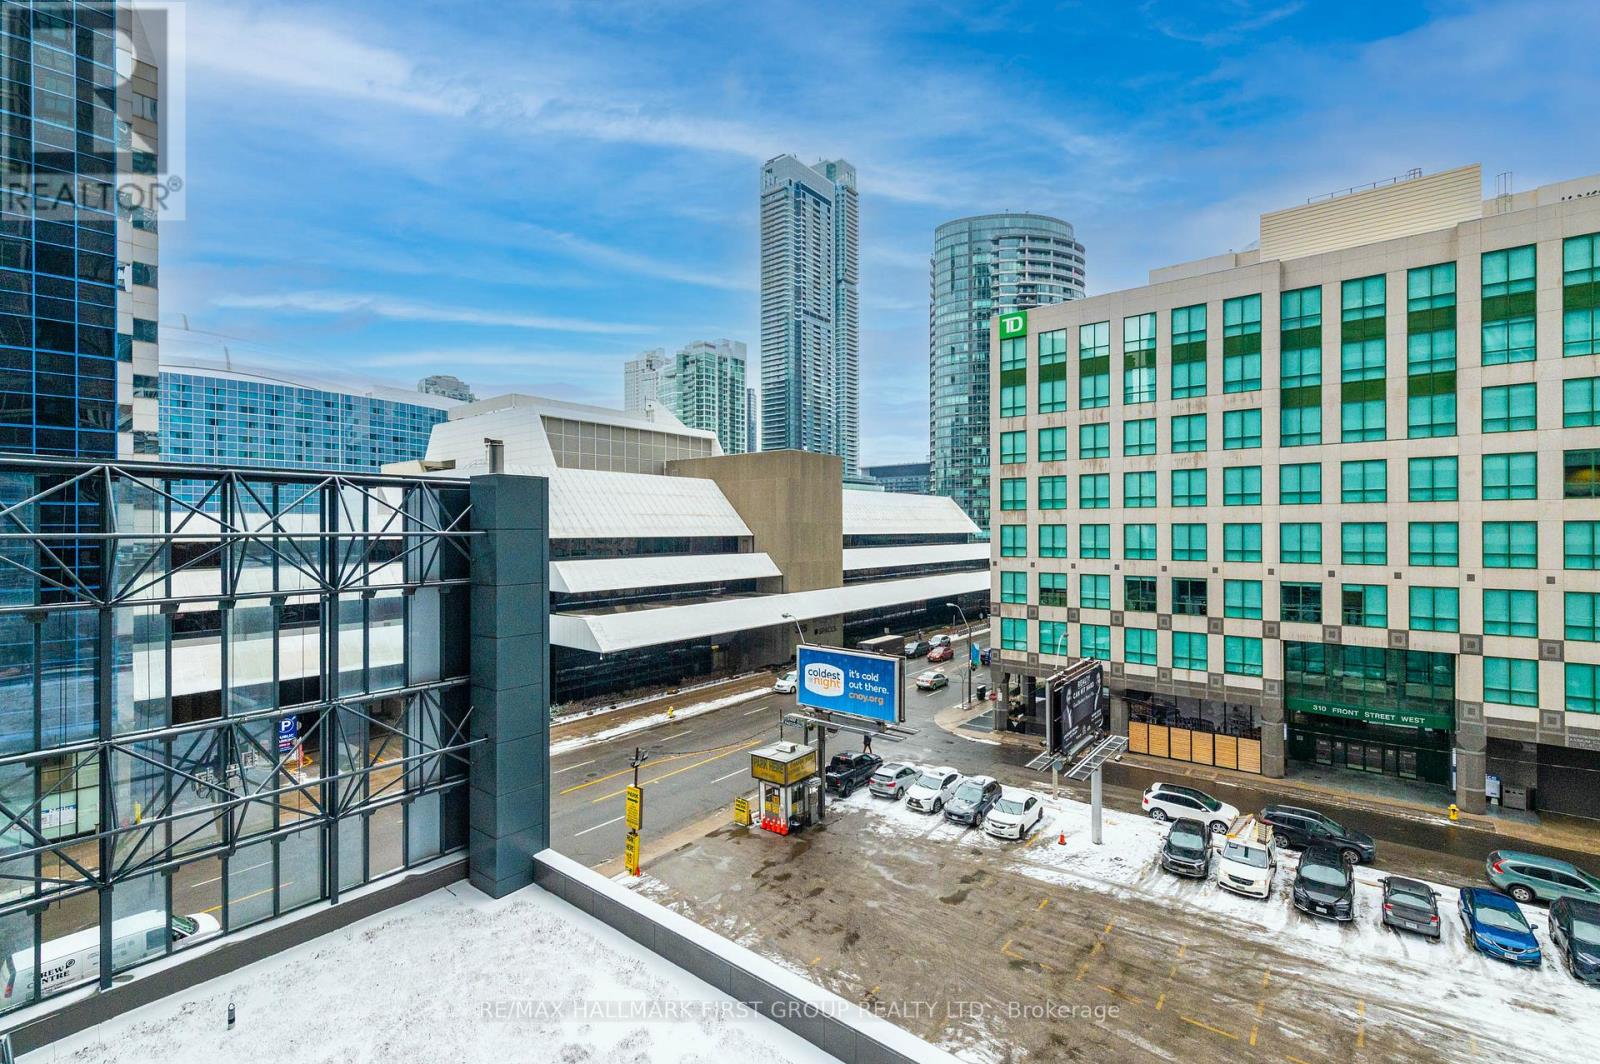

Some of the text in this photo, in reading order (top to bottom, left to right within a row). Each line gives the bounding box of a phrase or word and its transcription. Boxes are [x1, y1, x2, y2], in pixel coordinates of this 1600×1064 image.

[1002, 316, 1024, 333] TD
[808, 668, 841, 681] coldest
[848, 669, 879, 682] it's cold
[813, 677, 841, 690] night
[848, 682, 890, 695] out there.
[848, 691, 884, 704] cnoy.org
[1312, 704, 1425, 724] 310 FRONT STREET WEST
[281, 720, 291, 731] P
